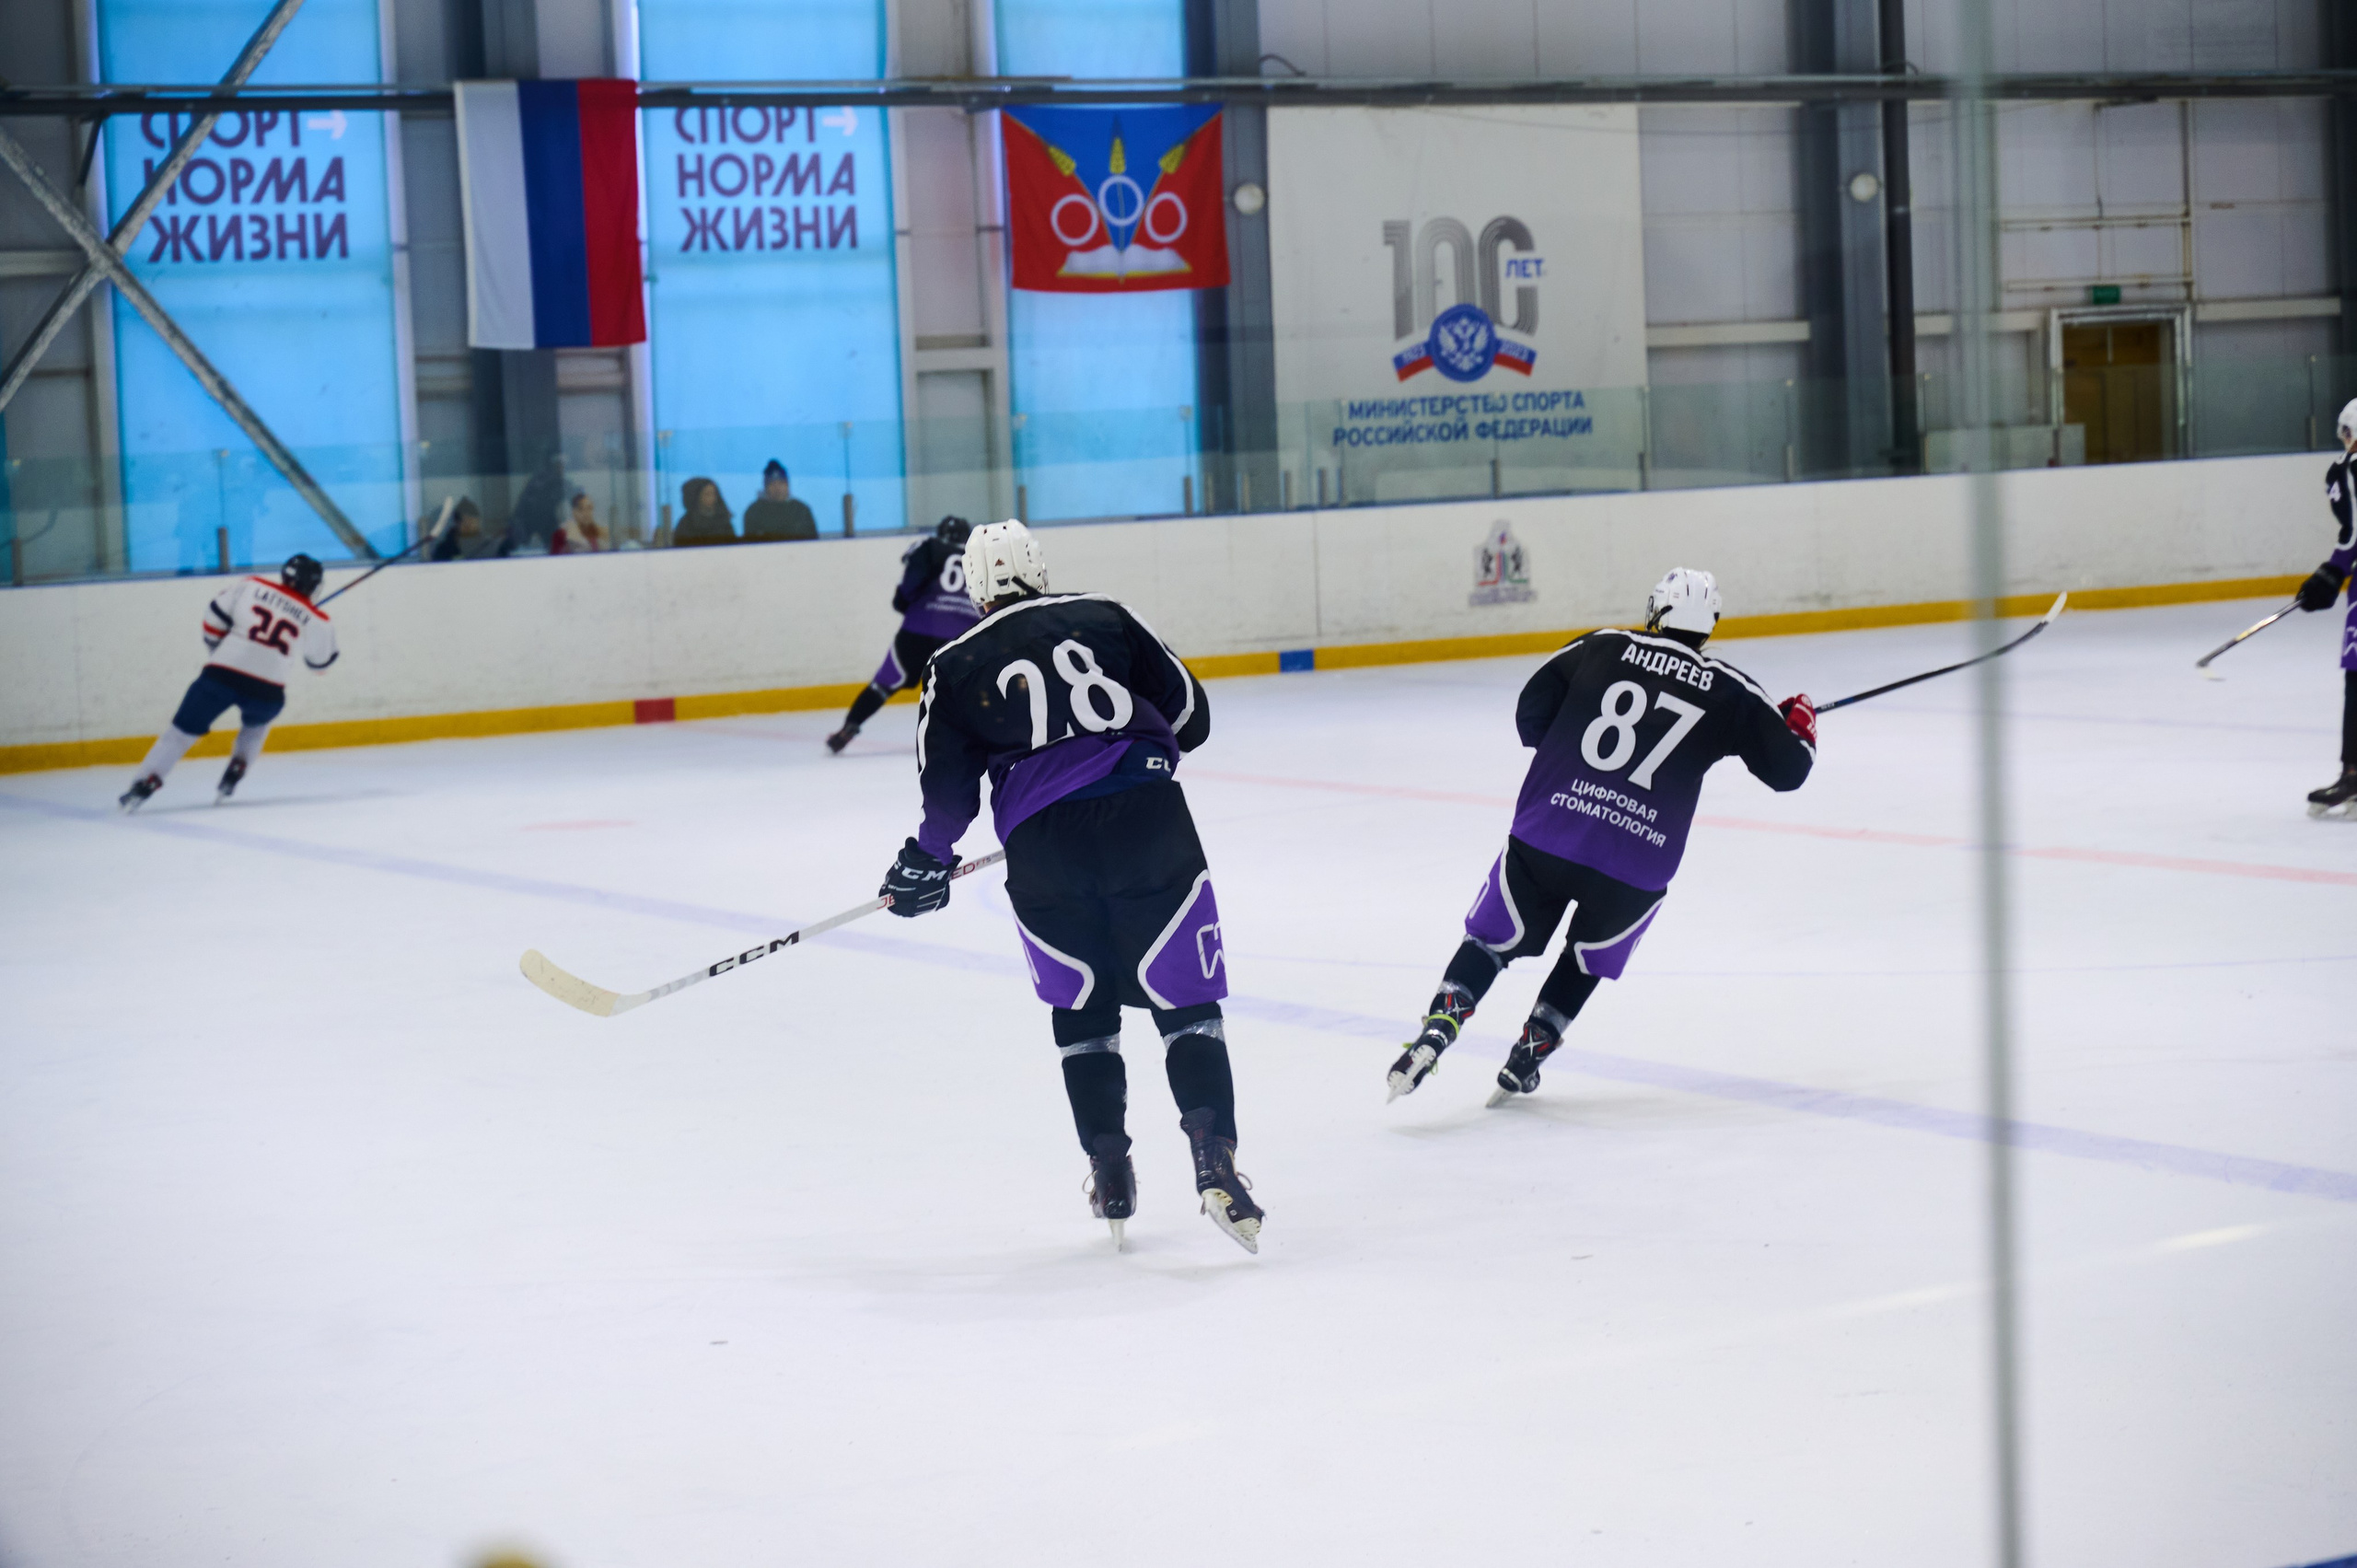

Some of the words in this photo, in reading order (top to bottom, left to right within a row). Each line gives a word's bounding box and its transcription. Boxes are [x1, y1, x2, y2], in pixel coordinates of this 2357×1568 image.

[674, 106, 817, 144] СПОРТ
[677, 152, 856, 198] НОРМА
[147, 213, 349, 263] ЖИЗНИ
[680, 204, 858, 252] ЖИЗНИ
[1505, 258, 1544, 279] ЛЕТ
[1512, 390, 1585, 412] СПОРТА
[1333, 416, 1469, 447] РОССИЙСКОЙ
[1475, 416, 1594, 441] ФЕДЕРАЦИИ
[940, 553, 969, 595] 6
[249, 605, 299, 656] 26
[1620, 644, 1715, 691] АНДРЕЕВ
[995, 639, 1133, 750] 28
[1581, 679, 1706, 791] 87
[1550, 792, 1667, 848] СТОМАТОЛОГИЯ
[1571, 778, 1658, 823] ЦИФРОВАЯ
[709, 930, 799, 977] CCM
